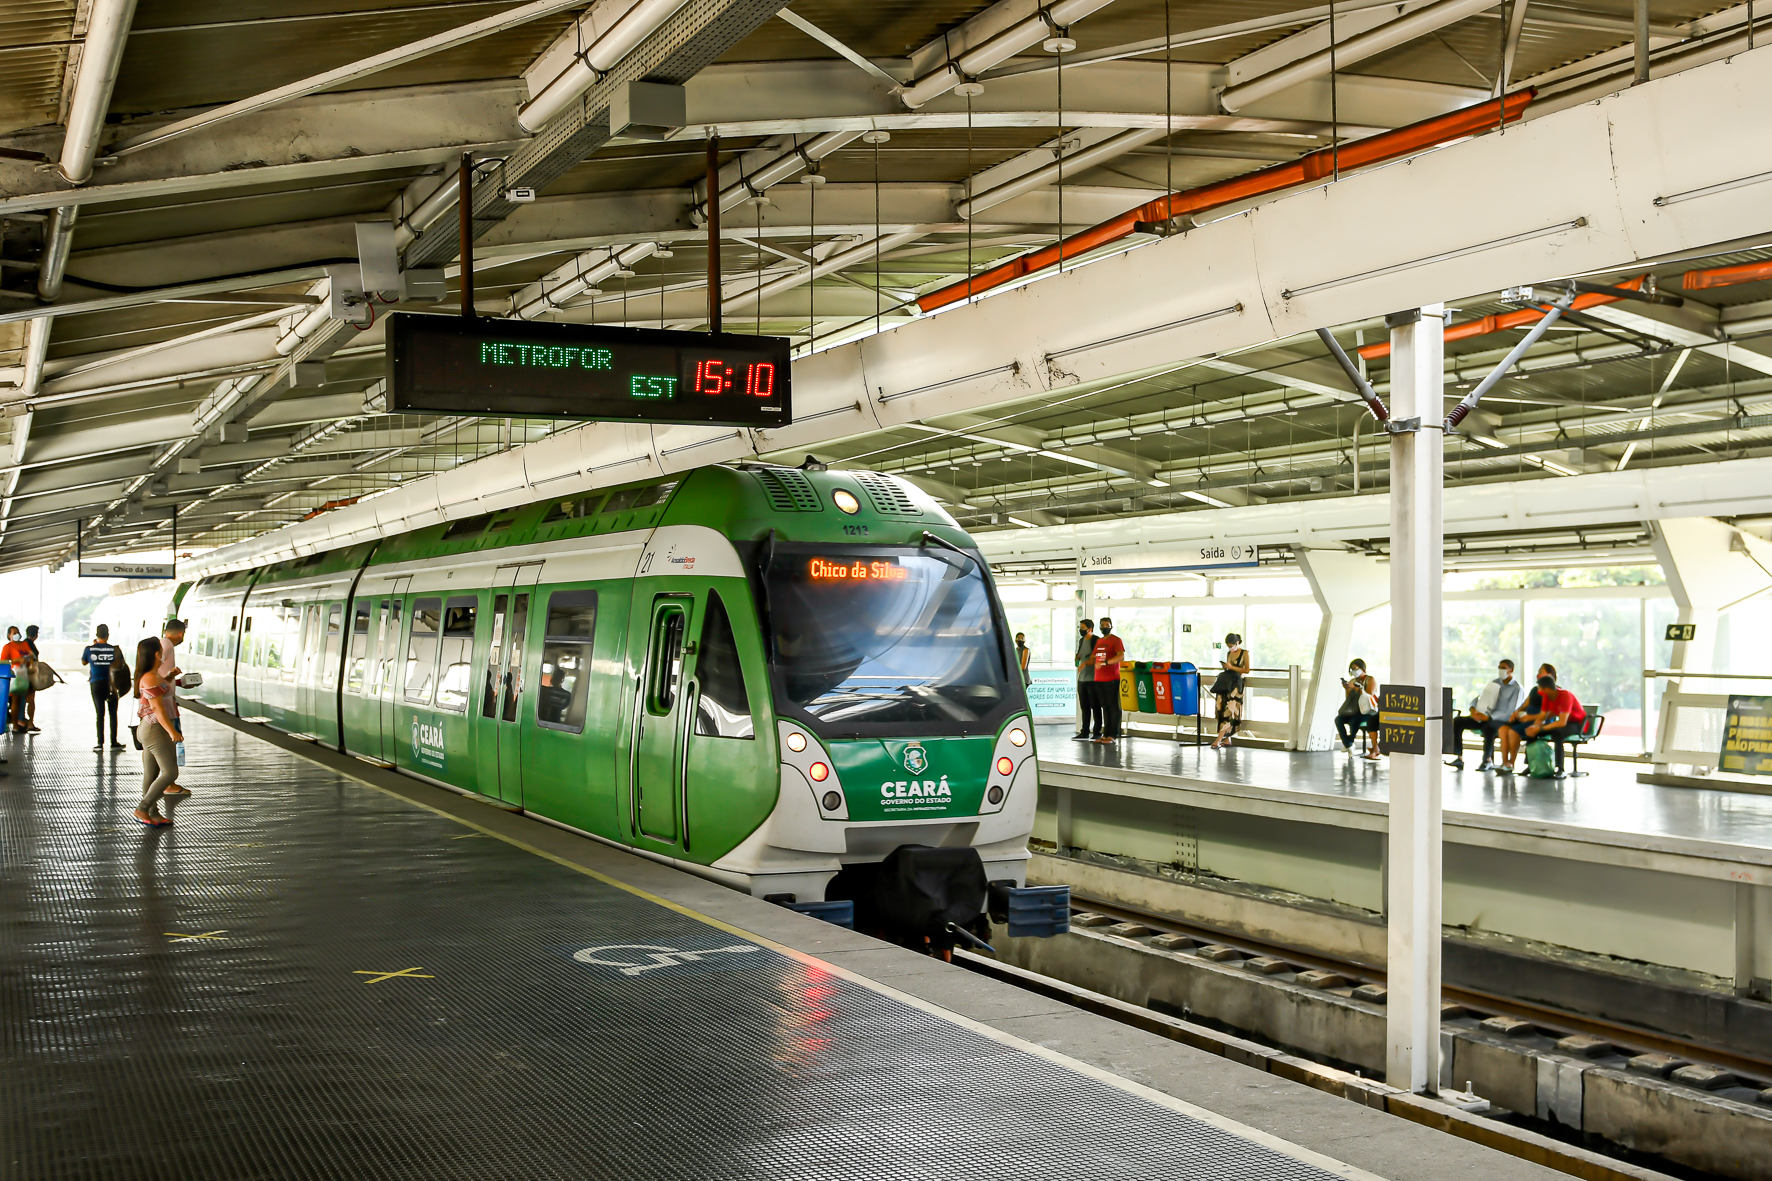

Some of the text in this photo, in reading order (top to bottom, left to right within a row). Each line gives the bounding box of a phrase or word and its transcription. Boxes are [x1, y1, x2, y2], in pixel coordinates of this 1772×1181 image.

[482, 343, 612, 370] METROFOR
[631, 360, 775, 398] EST 15:10
[843, 525, 868, 535] 1213
[641, 551, 656, 573] 21
[1200, 547, 1225, 559] Saída
[811, 560, 907, 579] Chico da Silva
[420, 721, 444, 749] CEARÁ
[1385, 727, 1415, 745] P577
[881, 774, 952, 798] CEARÁ
